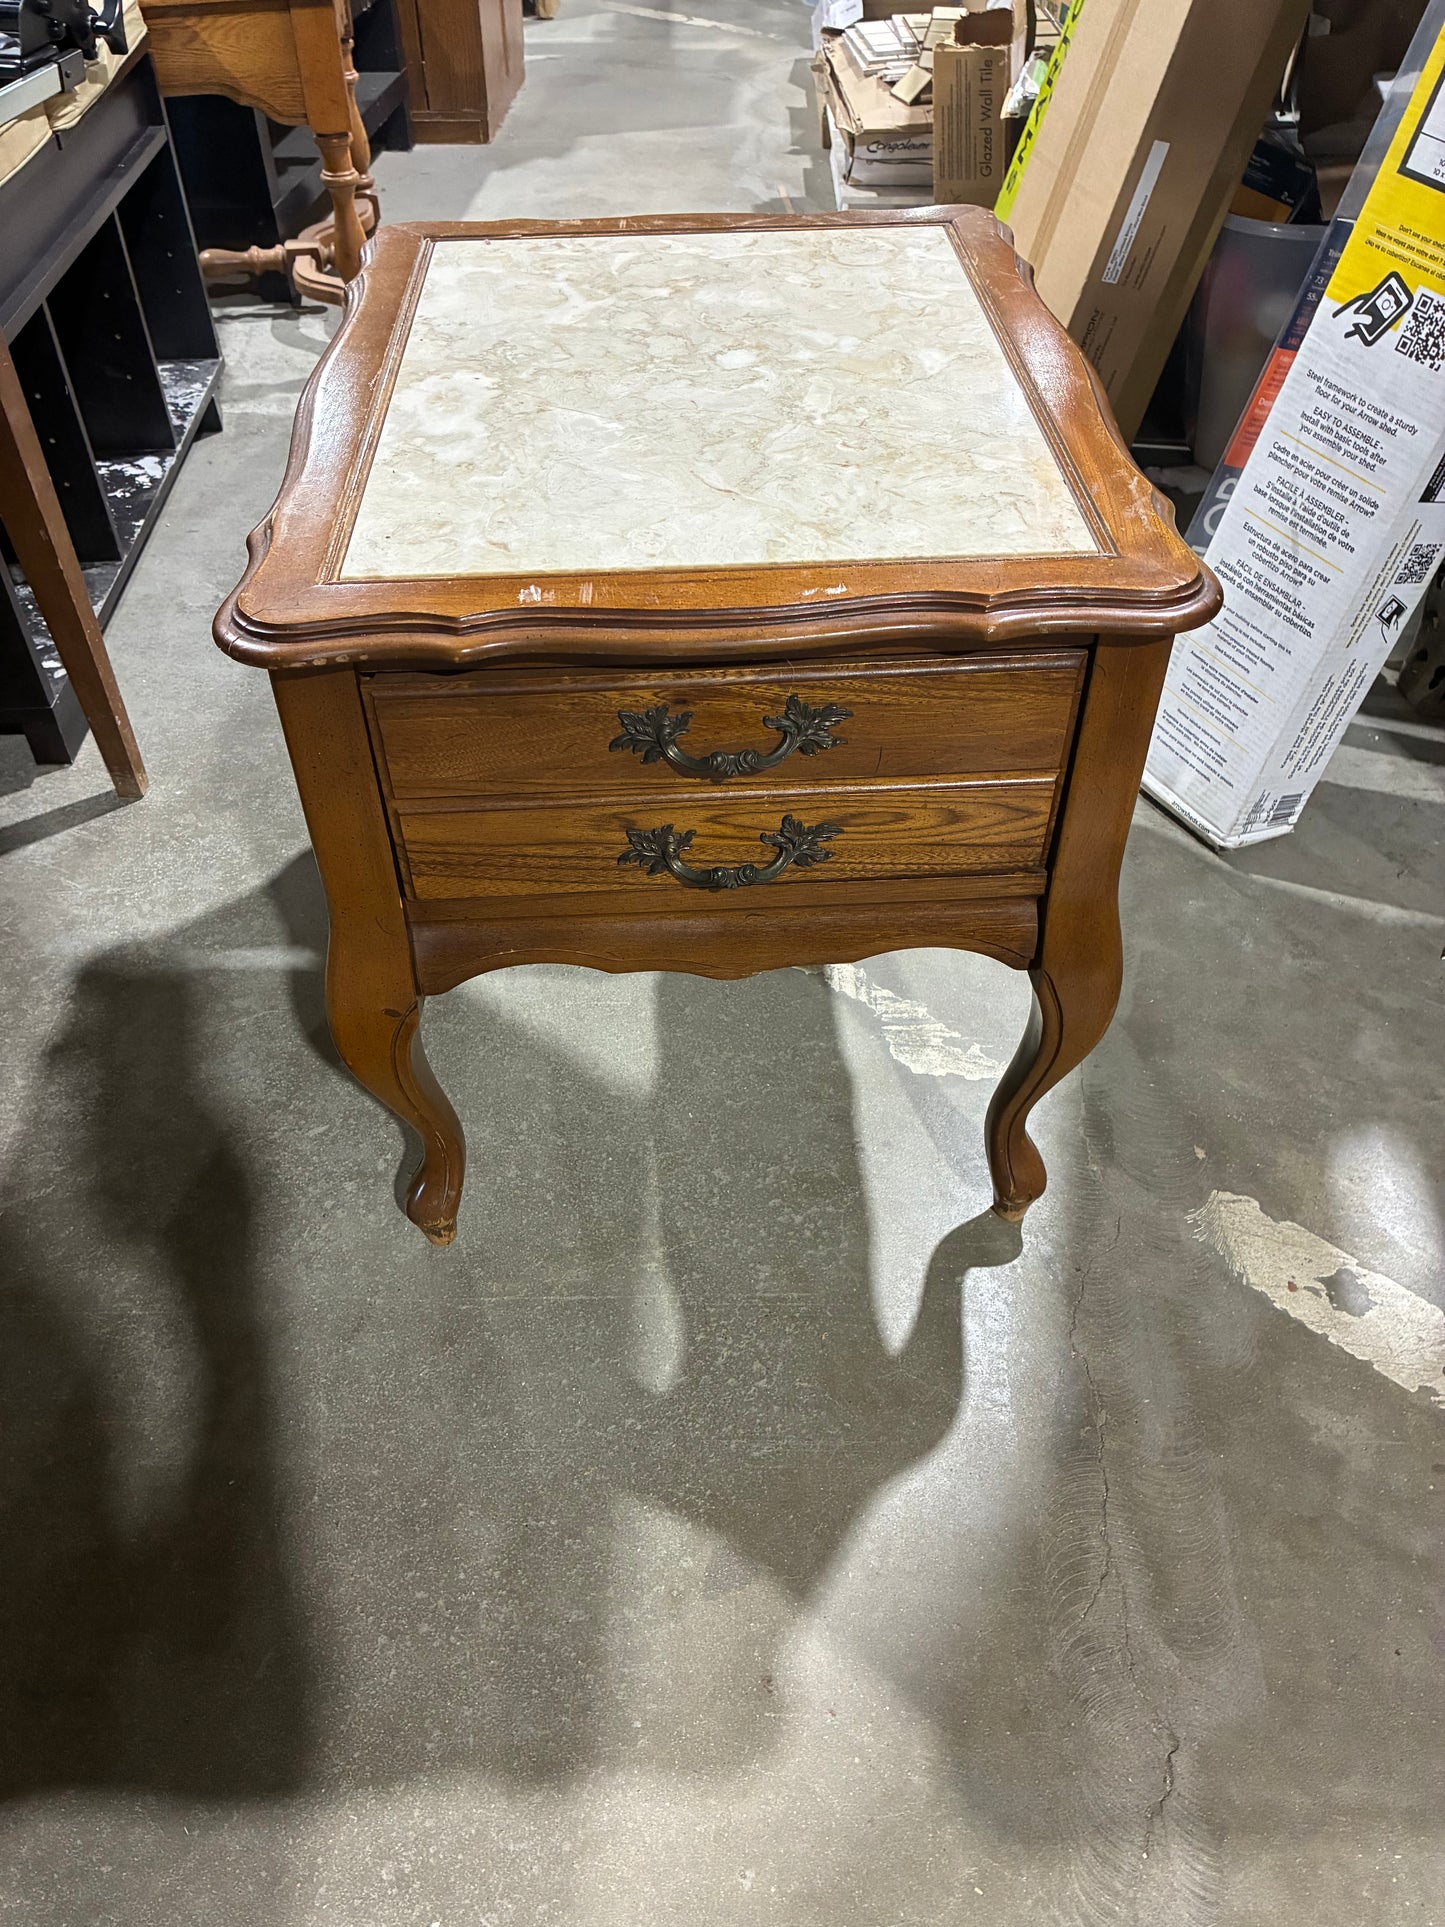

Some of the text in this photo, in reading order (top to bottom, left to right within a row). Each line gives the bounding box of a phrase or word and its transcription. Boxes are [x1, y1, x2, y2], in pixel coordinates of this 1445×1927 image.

[978, 59, 993, 177] Glazed Wall Tile
[1307, 369, 1324, 383] Steel
[1323, 378, 1358, 402] framework
[1358, 397, 1366, 407] to
[1367, 404, 1388, 419] create
[1395, 419, 1418, 436] sturdy
[1313, 406, 1332, 422] EASY
[1332, 417, 1342, 428] TO
[1343, 424, 1380, 449] ASSEMBLE
[1315, 385, 1398, 437] floor for your Arrow shed.
[1299, 424, 1376, 472] you assemble your shed.
[1300, 411, 1387, 465] Install with basic tools after
[1268, 451, 1294, 470] plancher
[1294, 467, 1309, 480] pour
[1310, 477, 1326, 491] votre
[1327, 487, 1348, 504] remise
[1273, 441, 1379, 510] Cadre en acier pour créer un solide
[1276, 476, 1299, 495] FACILE
[1298, 489, 1305, 499] À
[1305, 495, 1345, 523] ASSEMBLER
[1254, 484, 1355, 553] base lorsque l'installation de votre
[1266, 481, 1292, 502] S'installe
[1299, 502, 1316, 517] l'aide
[1317, 514, 1340, 532] d'outils
[1341, 529, 1350, 538] de
[1268, 507, 1288, 523] remise
[1289, 520, 1299, 530] est
[1243, 522, 1331, 584] Estructura de acero para crear
[1248, 538, 1316, 586] un robusto piso para su
[1252, 552, 1279, 573] cobertizo
[1236, 582, 1244, 591] de
[1245, 589, 1274, 611] ensamblar
[1275, 609, 1282, 617] su
[1283, 615, 1312, 639] cobertizo.
[1243, 576, 1254, 587] con
[1254, 583, 1292, 613] herramientas
[1292, 609, 1315, 629] básicas
[1253, 571, 1263, 582] DE
[1263, 578, 1302, 608] ENSAMBLAR
